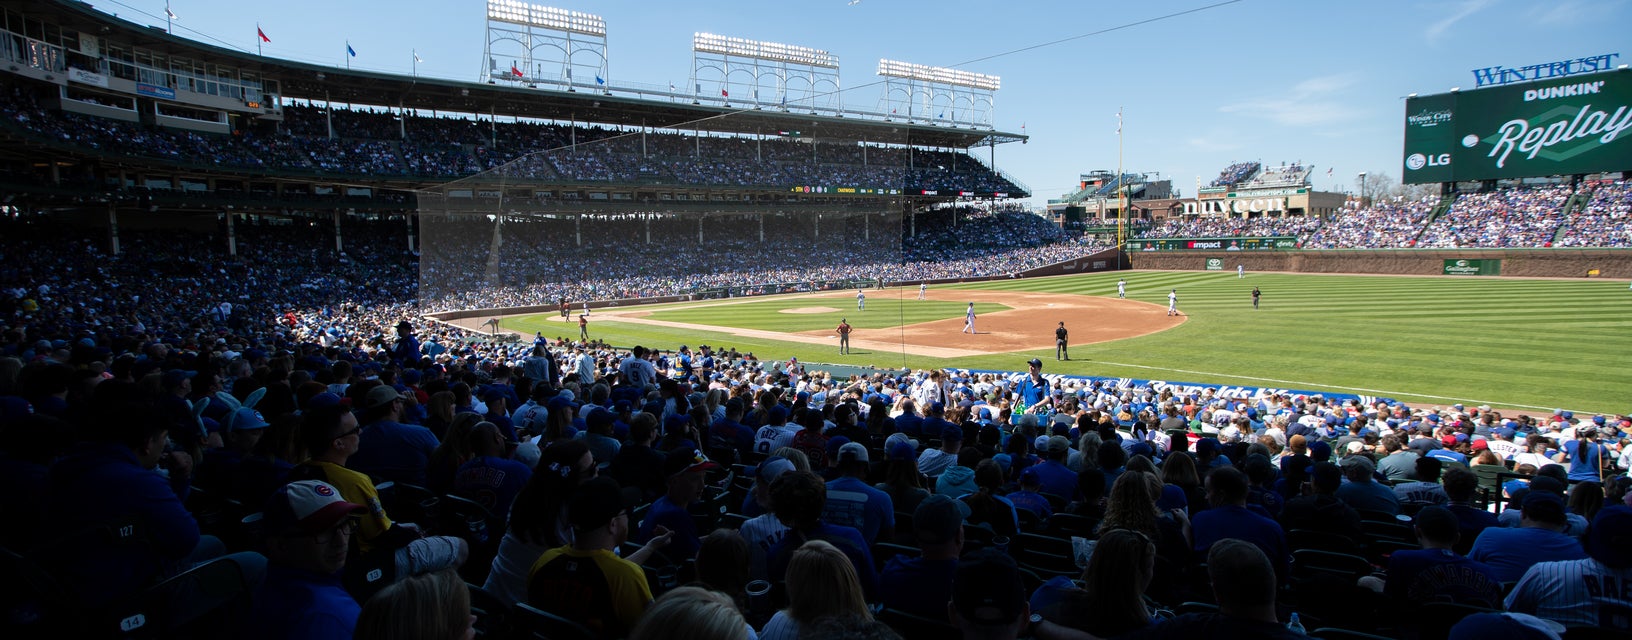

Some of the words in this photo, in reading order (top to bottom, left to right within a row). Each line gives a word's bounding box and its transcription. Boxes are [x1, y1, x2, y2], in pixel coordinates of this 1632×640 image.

[1524, 81, 1605, 102] DUNKIN'
[1487, 104, 1632, 168] Replay
[1428, 154, 1451, 166] LG
[1183, 197, 1283, 214] nuveen
[1193, 240, 1221, 249] impact
[119, 524, 134, 537] 127
[370, 571, 379, 580] 13
[126, 617, 139, 628] 14
